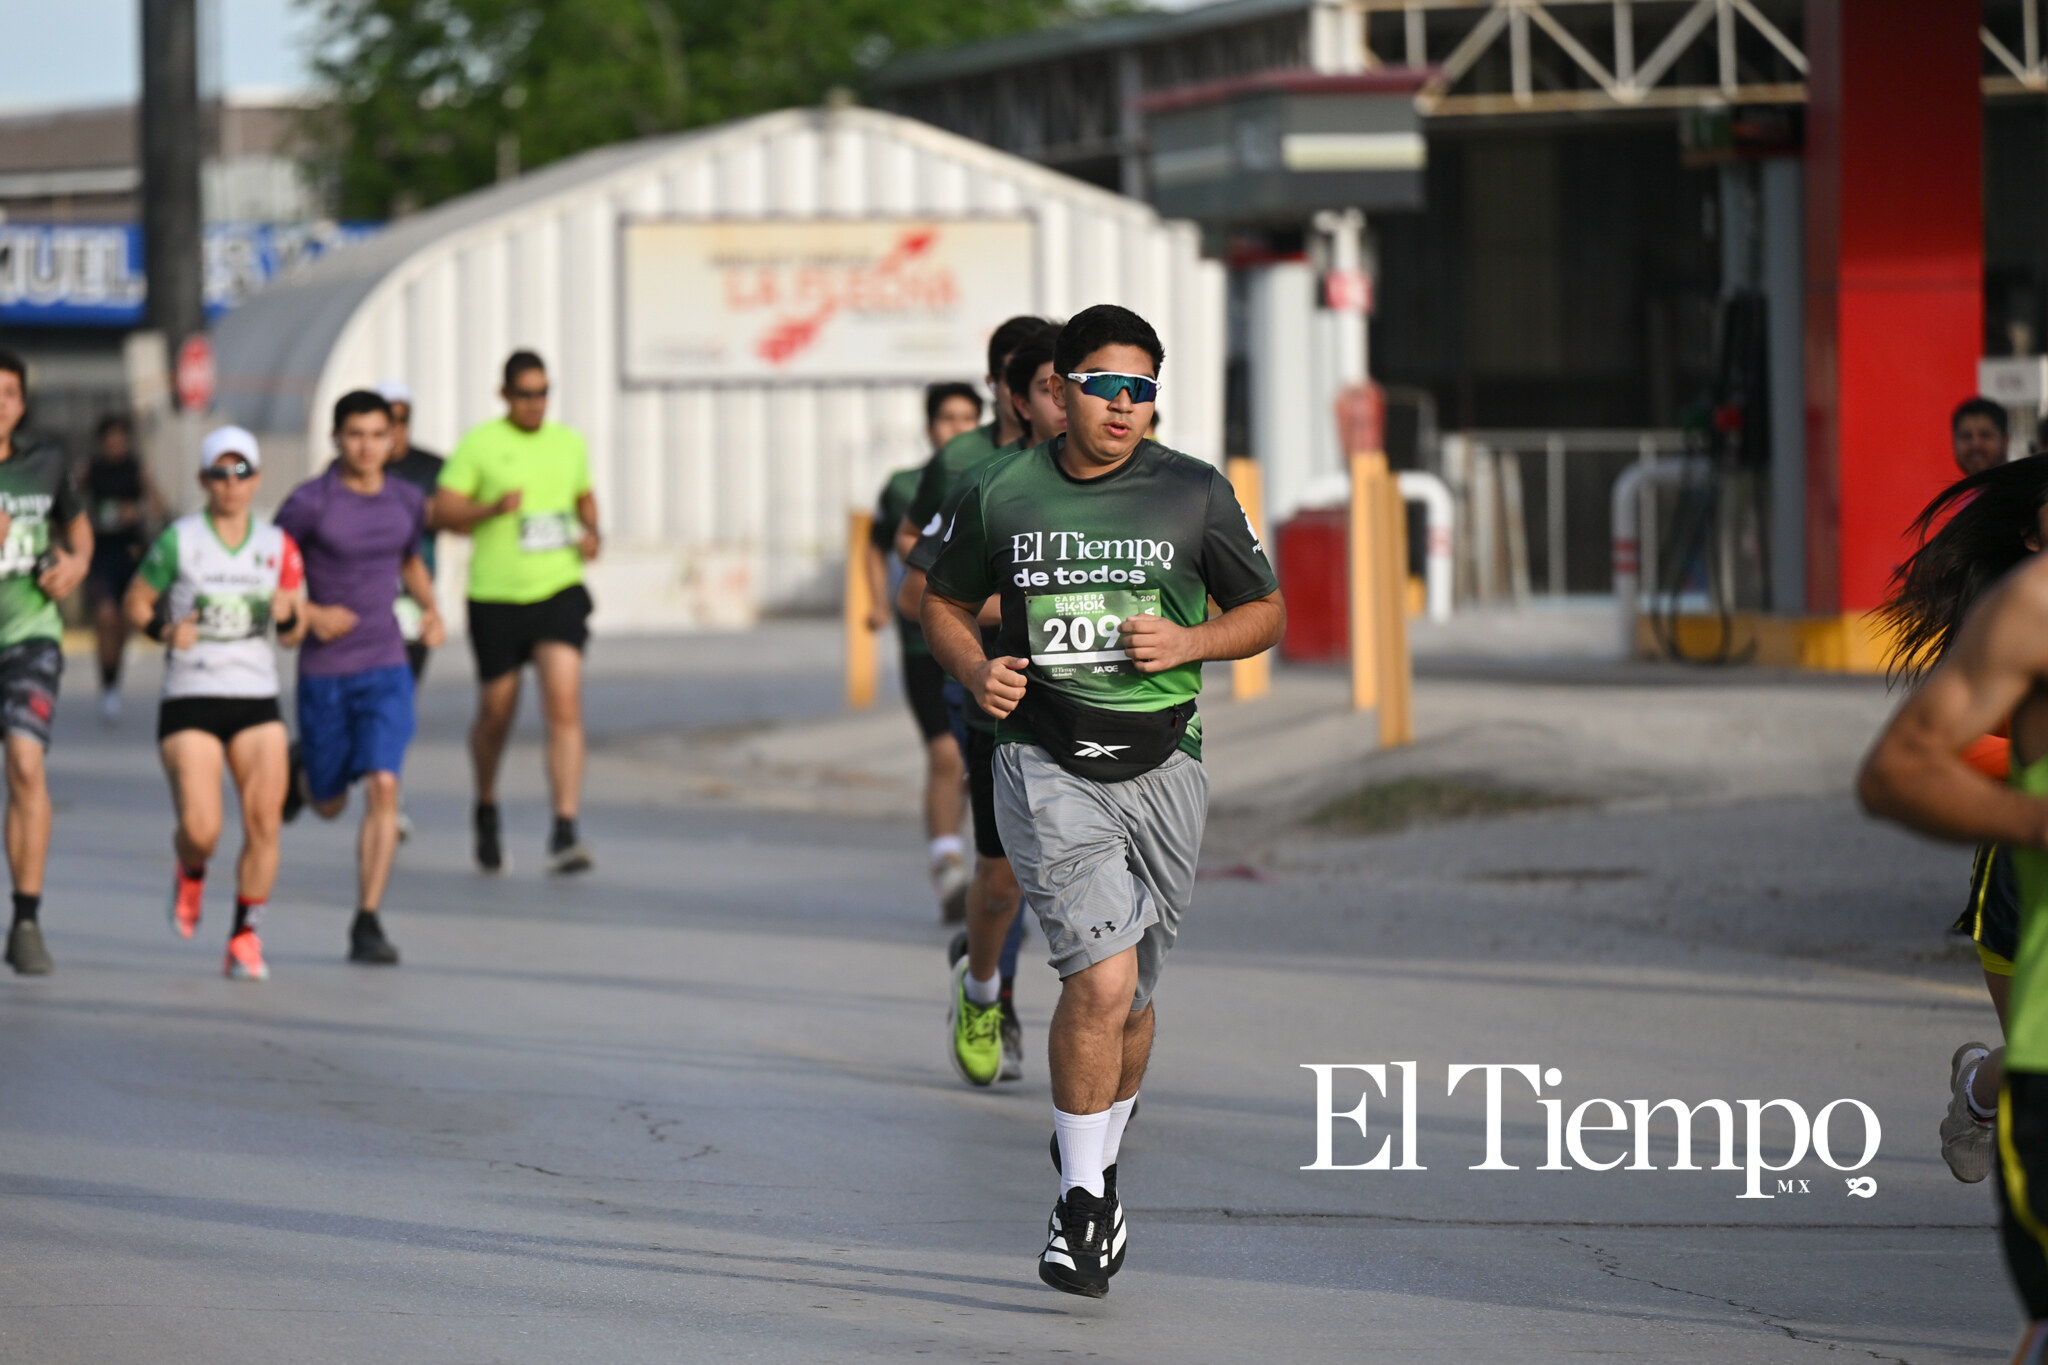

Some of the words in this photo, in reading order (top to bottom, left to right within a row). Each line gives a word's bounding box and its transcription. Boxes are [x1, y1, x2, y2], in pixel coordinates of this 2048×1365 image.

[1011, 531, 1045, 564] El
[1050, 531, 1175, 567] Tiempo
[1013, 568, 1050, 588] de
[1053, 565, 1146, 585] todos
[1054, 593, 1105, 603] CARRERA
[1140, 594, 1157, 602] 209
[1043, 614, 1122, 653] 209
